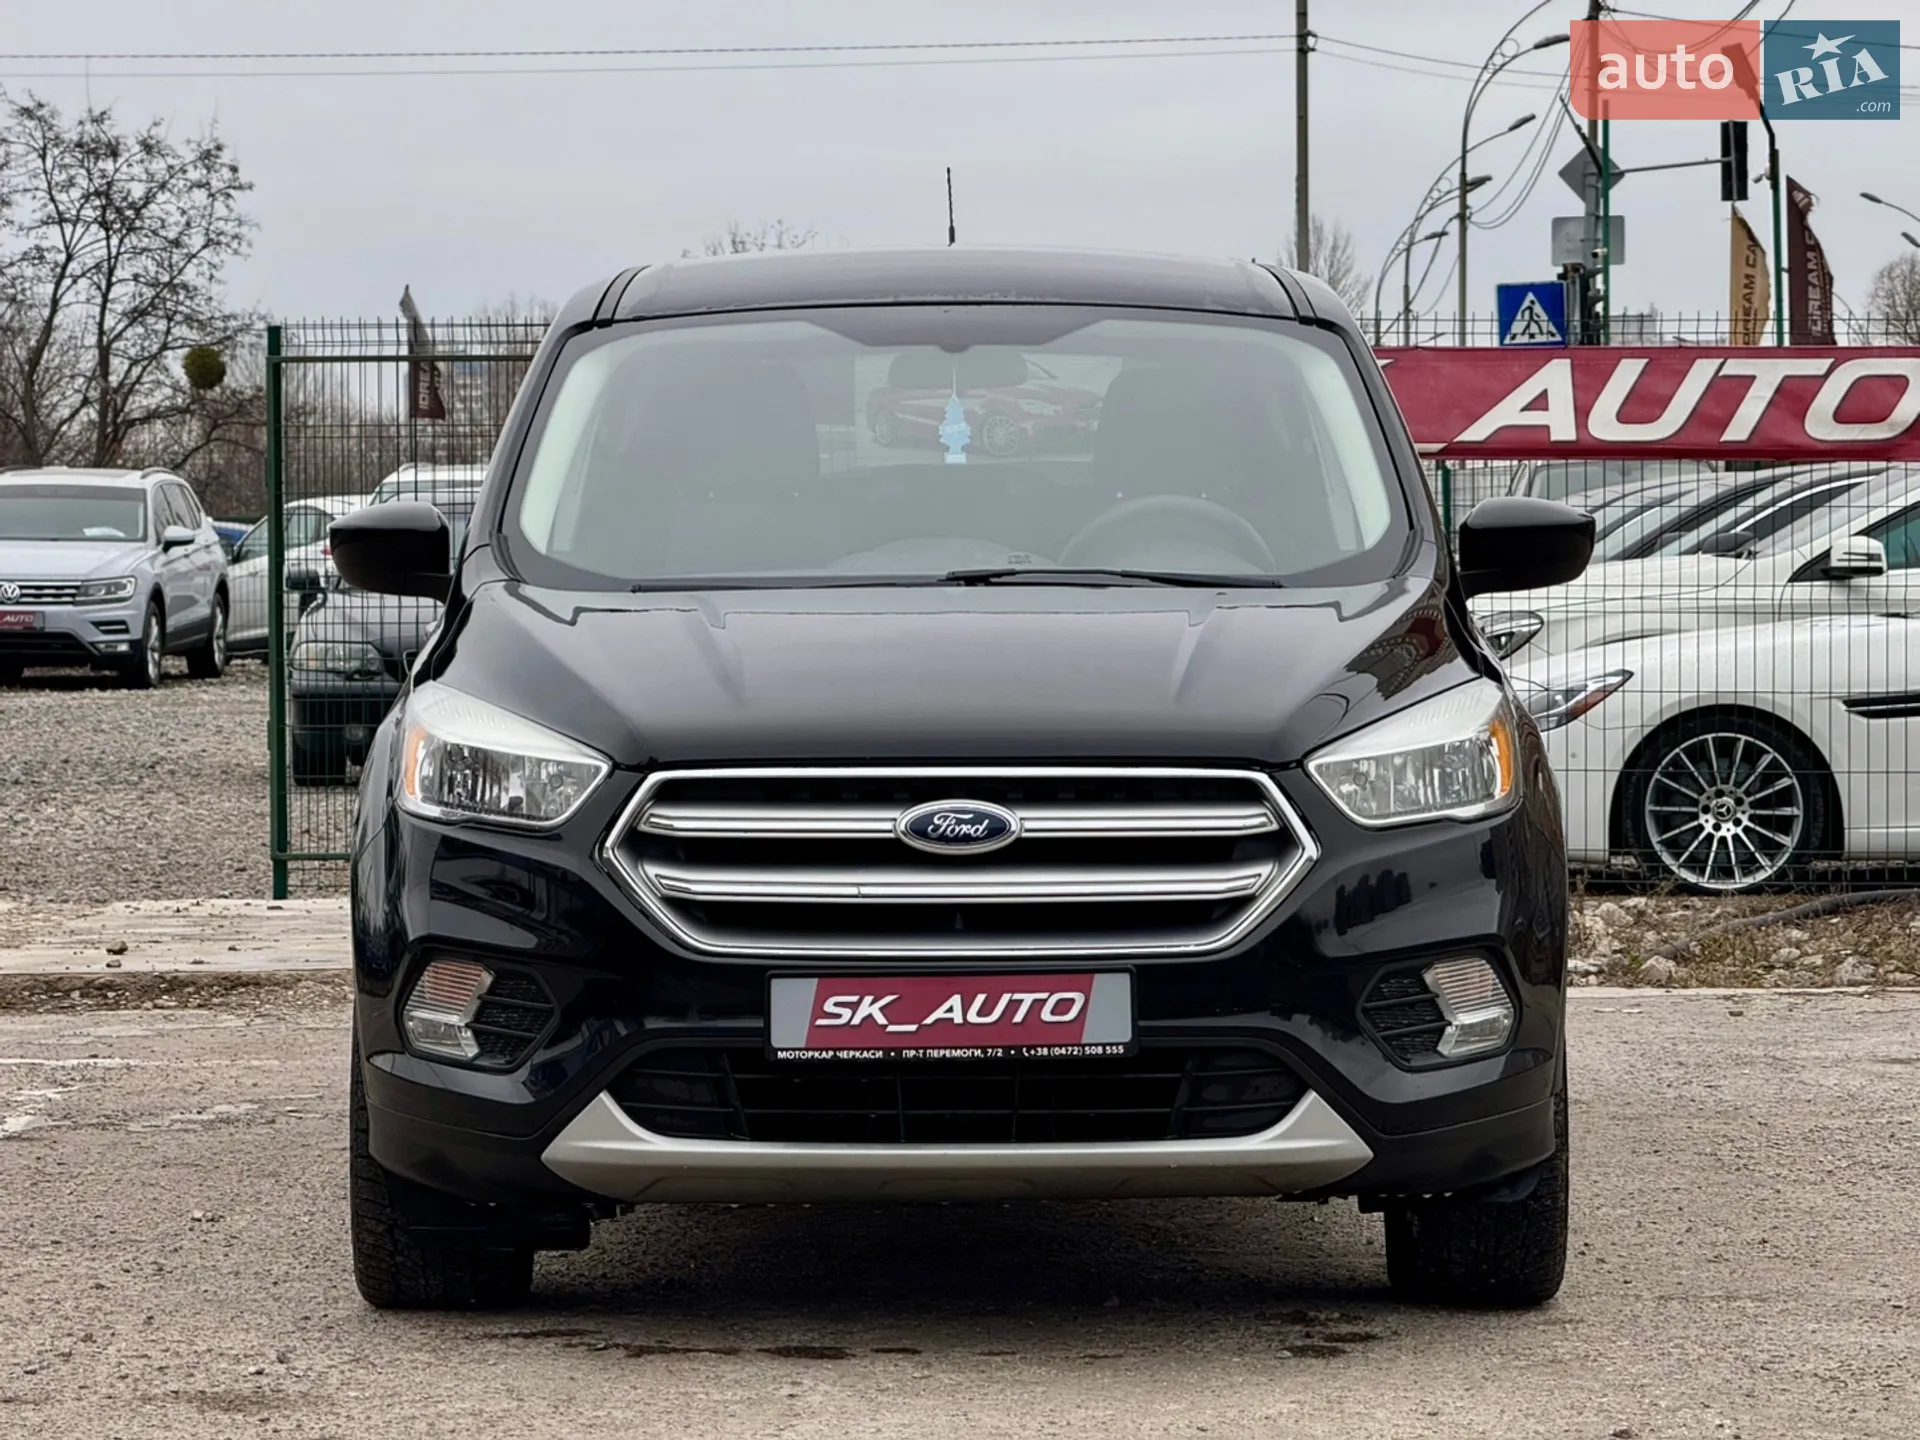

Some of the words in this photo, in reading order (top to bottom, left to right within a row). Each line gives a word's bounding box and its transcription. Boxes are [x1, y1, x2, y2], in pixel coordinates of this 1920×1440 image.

[1377, 357, 1920, 452] AUTO
[927, 812, 990, 839] Ford
[815, 991, 1086, 1032] SK_AUTO
[777, 1050, 835, 1059] МОТОРКАР
[836, 1050, 883, 1059] ЧЕРКАСИ
[926, 1048, 984, 1058] ПЕРЕМОГИ,
[986, 1048, 1003, 1057] 7/2
[1030, 1047, 1049, 1056] +38
[1050, 1046, 1083, 1057] (0472)
[1084, 1046, 1103, 1055] 508
[1105, 1045, 1124, 1055] 555
